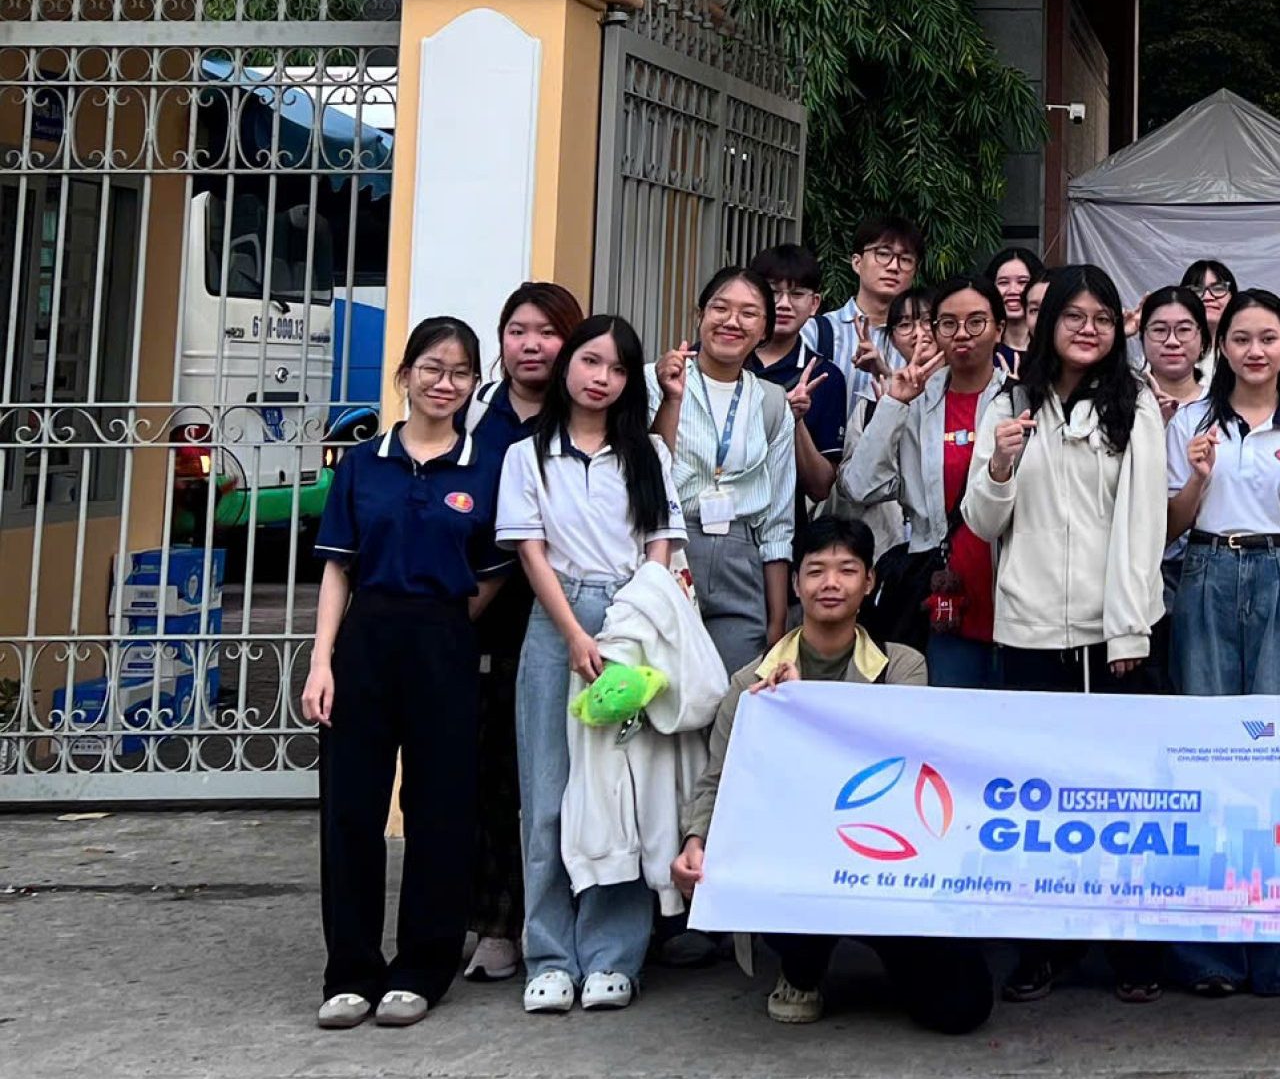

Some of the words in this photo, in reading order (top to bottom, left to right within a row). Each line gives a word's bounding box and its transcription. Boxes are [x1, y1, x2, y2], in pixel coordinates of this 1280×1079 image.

[983, 777, 1052, 811] GO
[1062, 790, 1199, 810] USSH-VNUHCM
[979, 818, 1200, 856] GLOCAL
[833, 869, 869, 888] Học
[877, 871, 897, 886] từ
[942, 874, 1011, 896] nghiệm
[1110, 881, 1143, 897] văn
